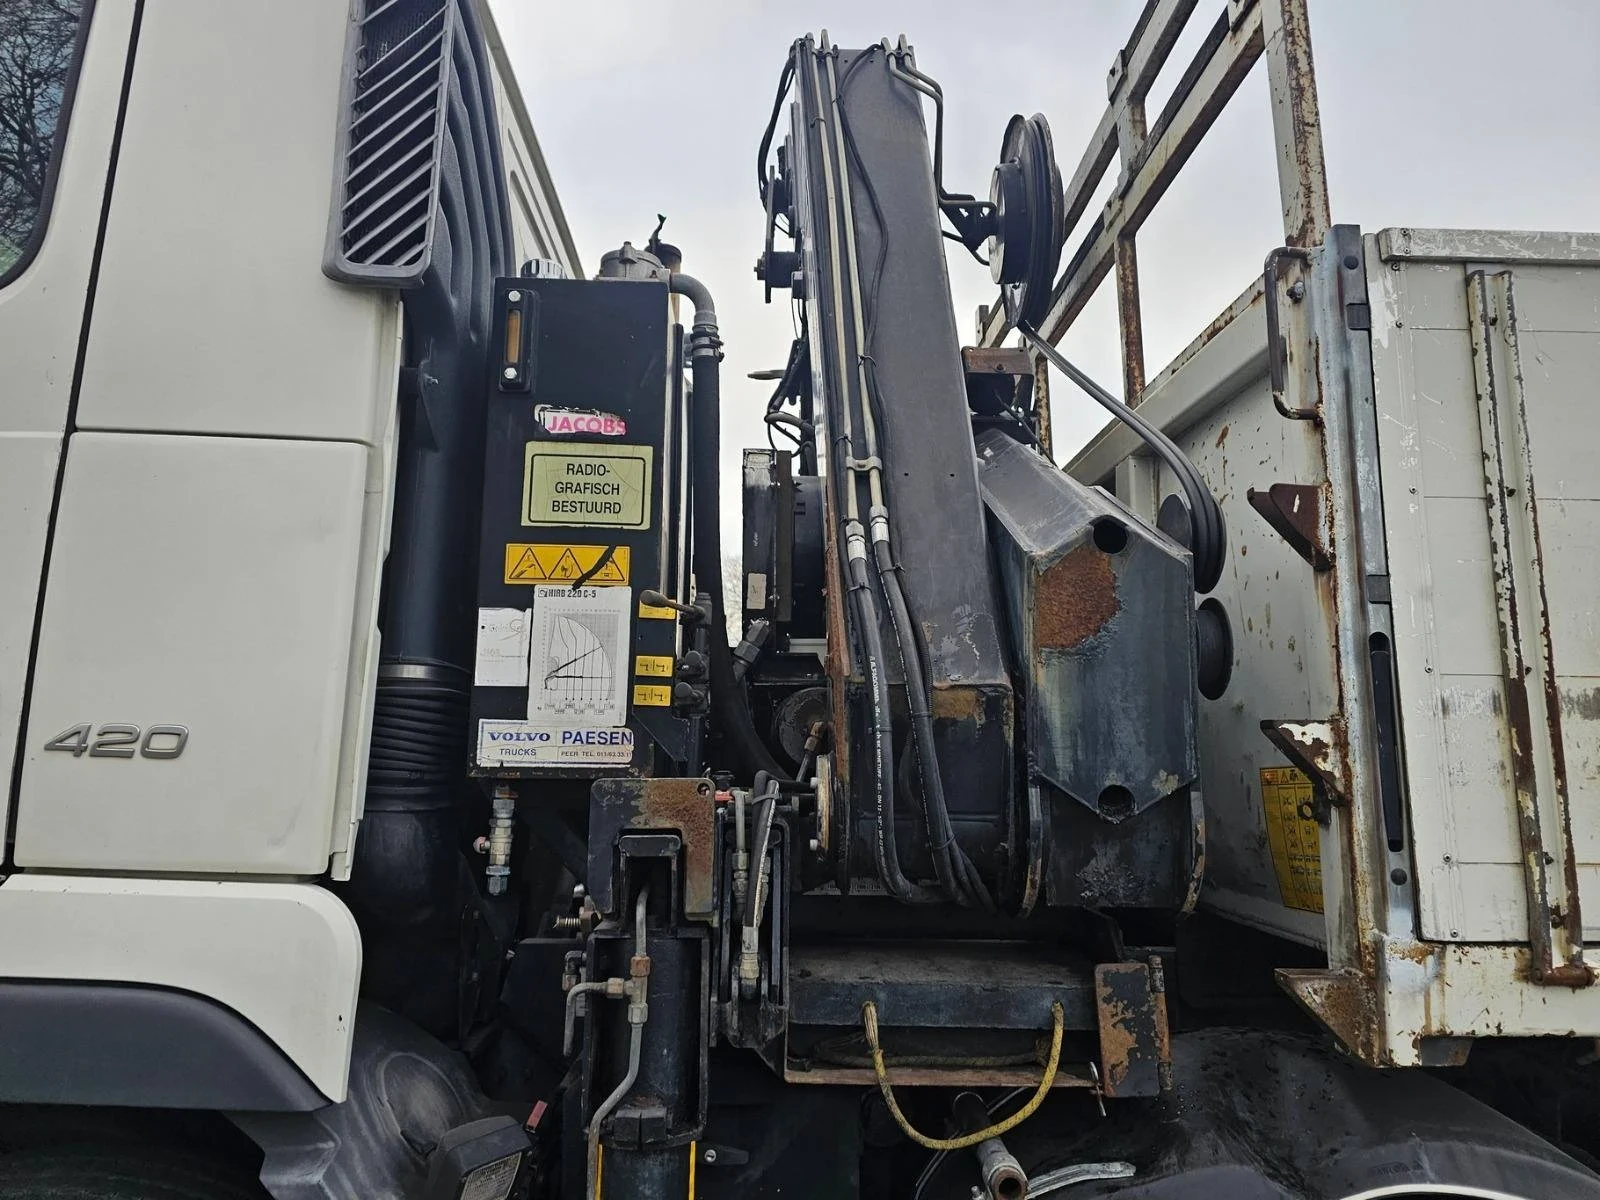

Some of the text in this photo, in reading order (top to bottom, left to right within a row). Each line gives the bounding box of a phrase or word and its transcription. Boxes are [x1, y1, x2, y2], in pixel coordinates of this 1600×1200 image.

[548, 415, 626, 435] JACOBS
[566, 463, 611, 477] RADIO-
[555, 481, 620, 496] GRAFISCH
[552, 500, 622, 514] BESTUURD
[548, 589, 597, 598] HIAB 220 C-5
[44, 723, 189, 759] 420
[488, 731, 633, 745] VOLVO PAESEN
[500, 748, 537, 756] TRUCKS
